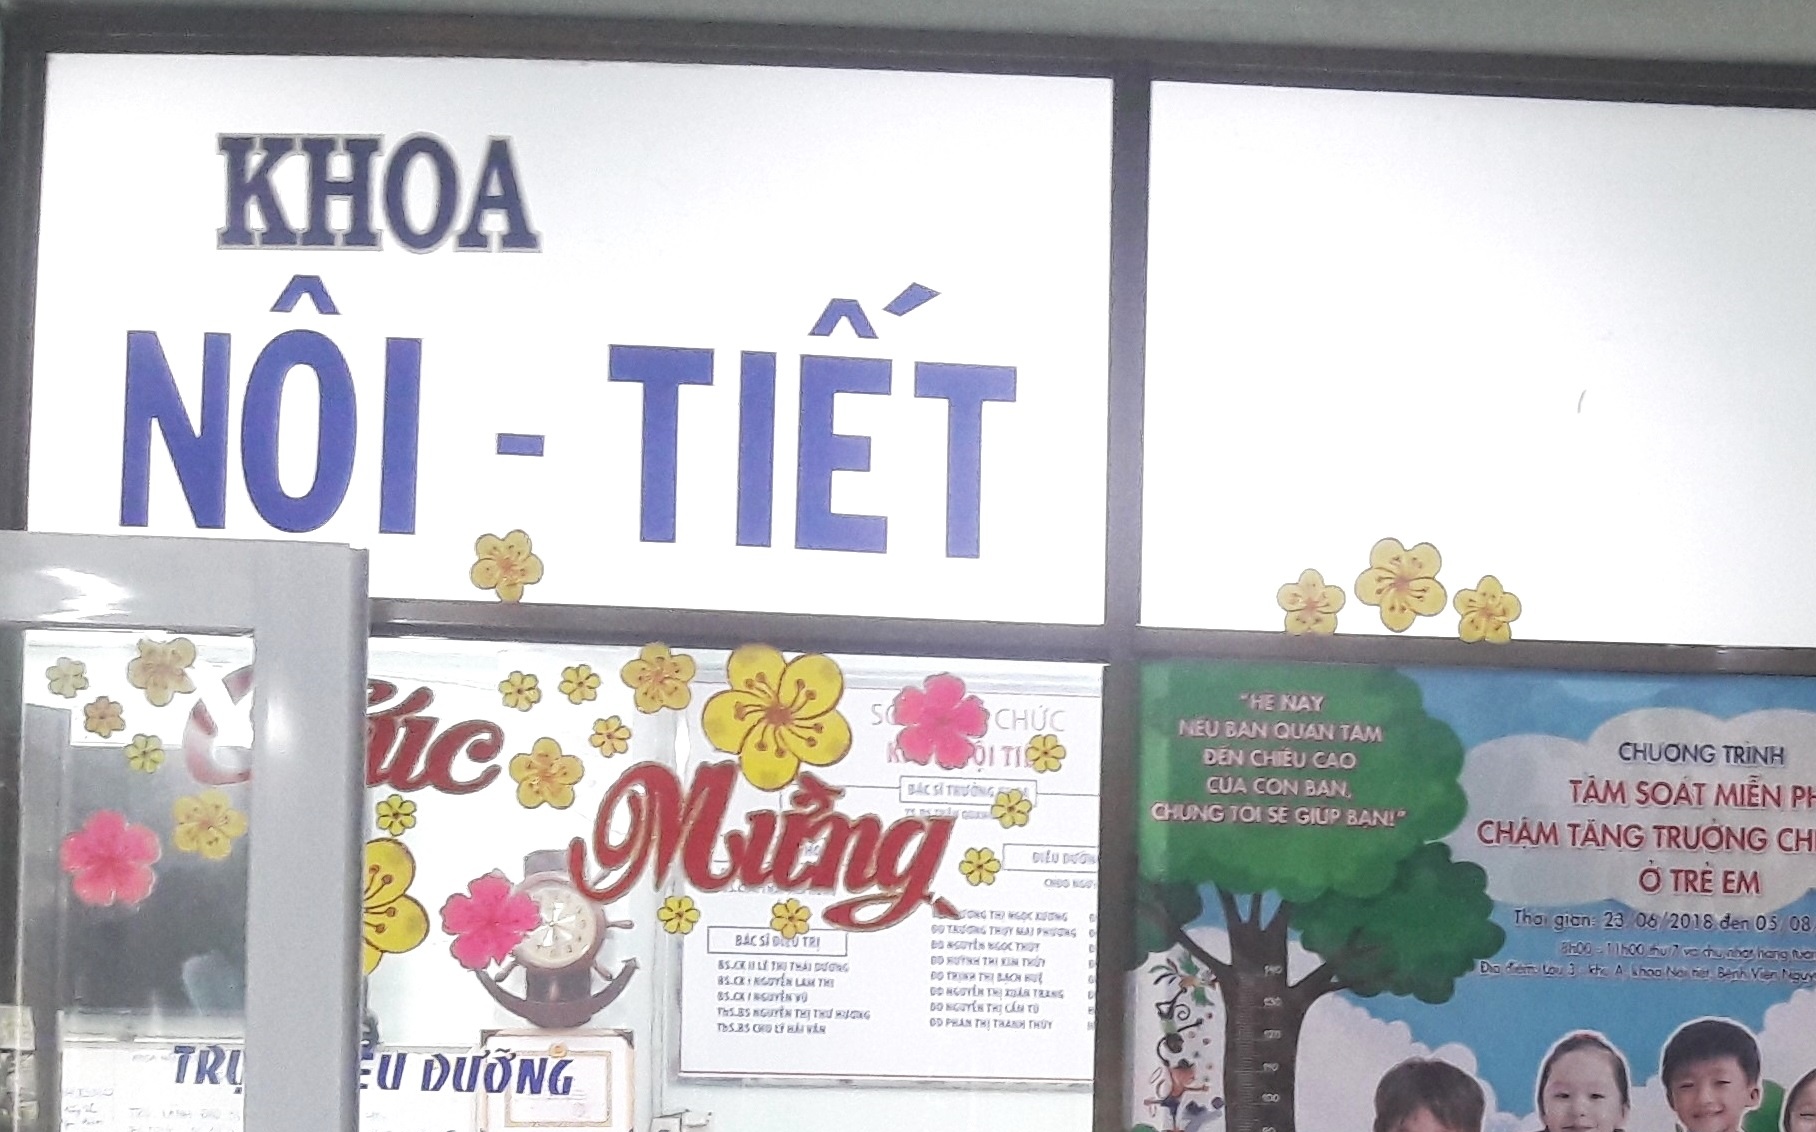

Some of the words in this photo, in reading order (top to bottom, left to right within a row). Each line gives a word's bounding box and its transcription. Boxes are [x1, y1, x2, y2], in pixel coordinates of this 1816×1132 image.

[217, 133, 541, 253] KHOA
[608, 282, 1017, 558] TIẾT
[1273, 722, 1335, 741] QUAN
[1313, 752, 1356, 770] CAO
[1253, 777, 1299, 796] CON
[569, 762, 960, 930] Mừng
[1722, 870, 1760, 895] EM
[421, 1048, 574, 1096] DƯỠNG
